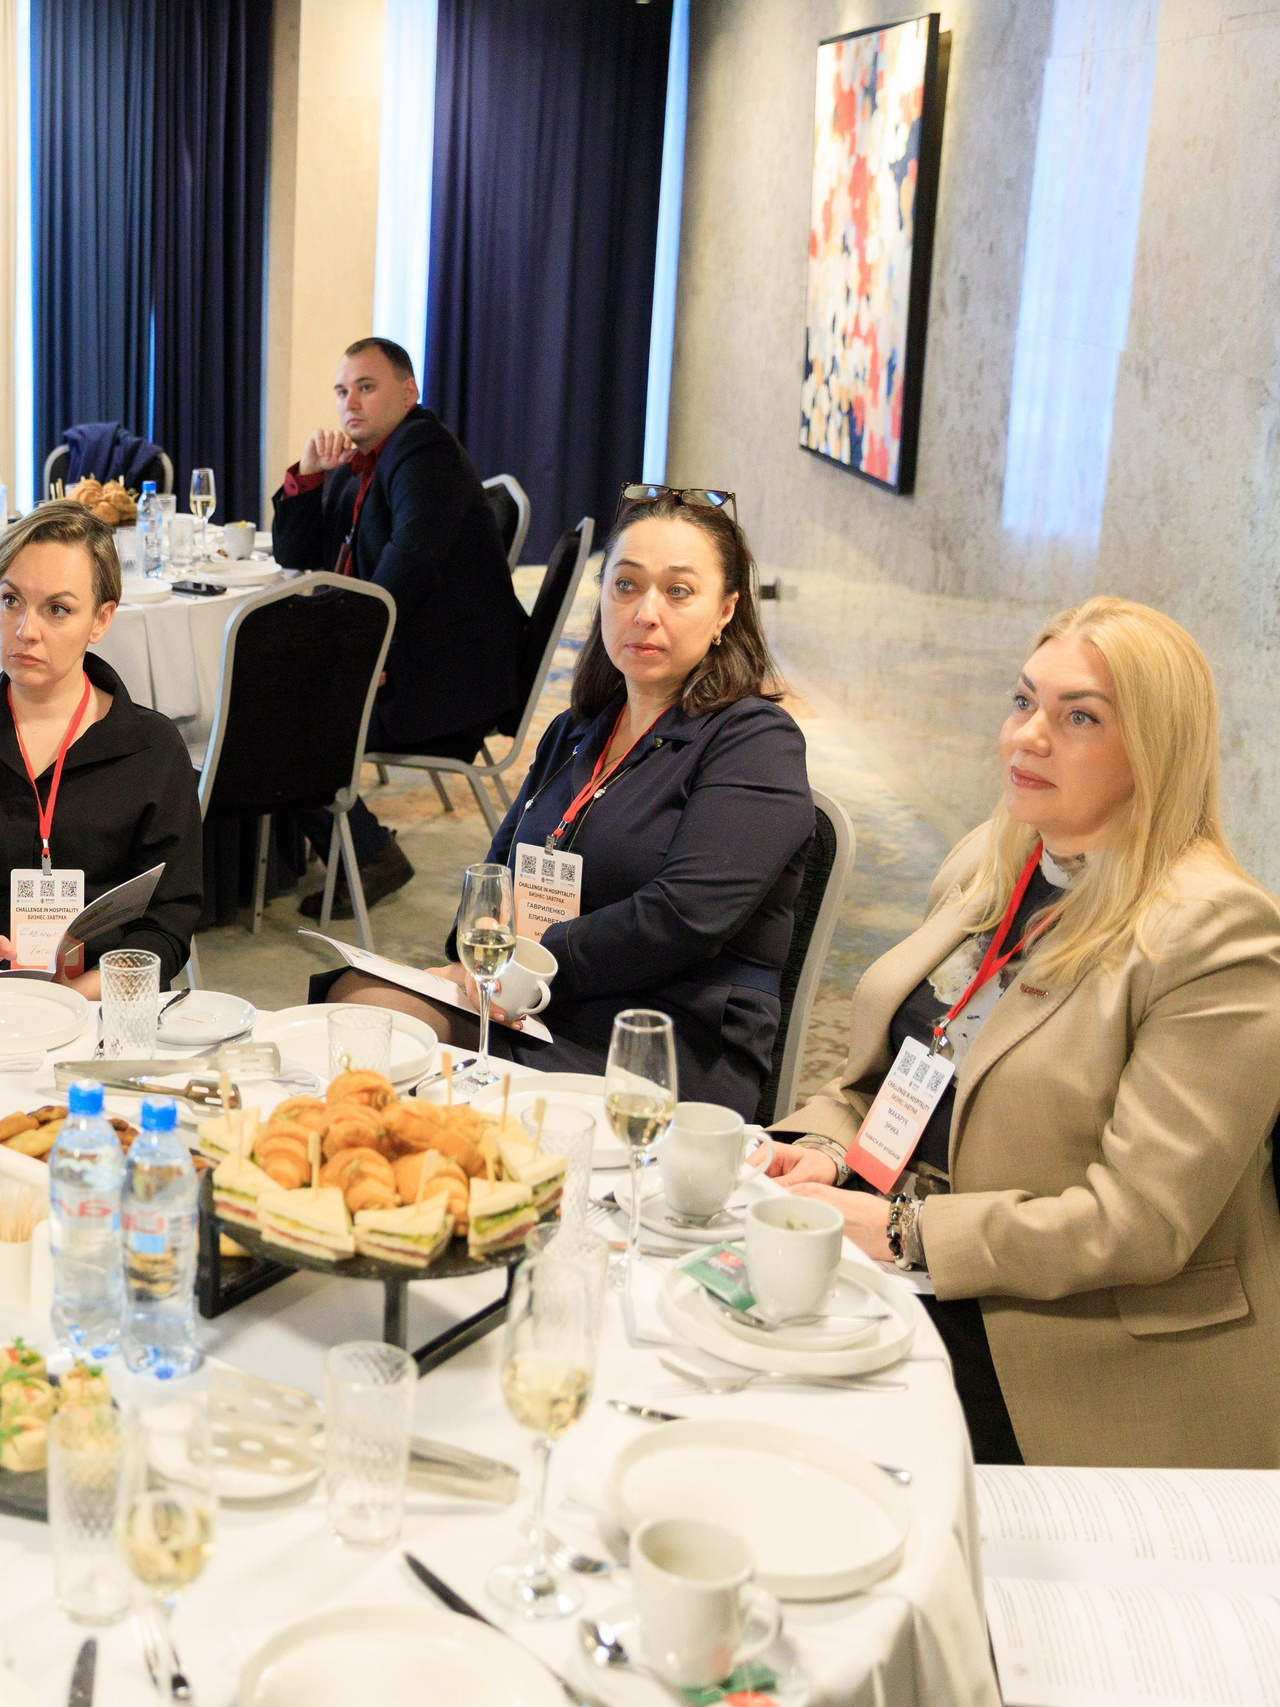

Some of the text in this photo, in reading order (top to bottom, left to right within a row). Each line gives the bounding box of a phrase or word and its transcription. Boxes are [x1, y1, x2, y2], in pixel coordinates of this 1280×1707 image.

[519, 881, 543, 892] CHALLENGE
[548, 887, 576, 898] HOSPITALITY
[528, 891, 565, 904] БИЗНЕС-ЗАВТРАК
[526, 901, 566, 916] ГАВРИЛЕНКО
[887, 1080, 907, 1096] CHALLENGE
[909, 1094, 930, 1112] HOSPITALITY
[883, 1121, 900, 1136] ЭРИКА
